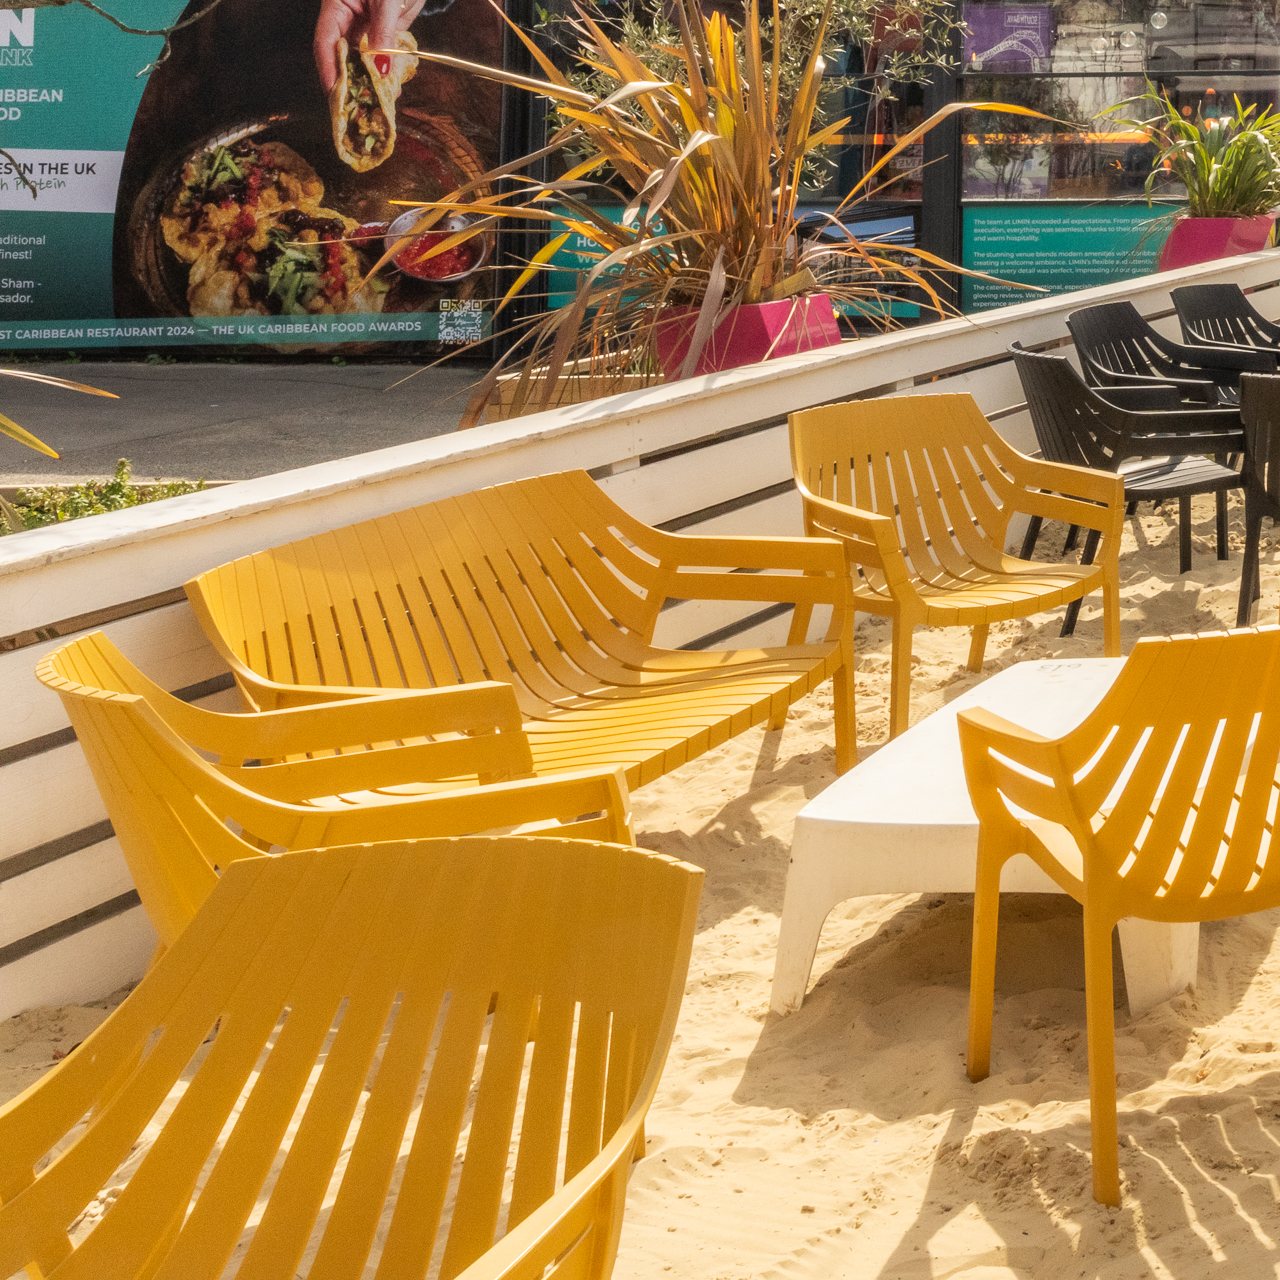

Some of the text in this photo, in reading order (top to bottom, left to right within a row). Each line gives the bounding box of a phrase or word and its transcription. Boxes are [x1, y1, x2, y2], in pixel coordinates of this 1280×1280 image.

[38, 162, 69, 175] THE
[74, 162, 97, 175] UK
[1, 278, 35, 289] Sham
[15, 328, 84, 340] CARIBBEAN
[87, 326, 164, 338] RESTAURANT
[167, 325, 195, 336] 2024
[212, 324, 235, 336] THE
[238, 324, 255, 335] UK
[258, 322, 328, 335] CARIBBEAN
[331, 322, 366, 333] FOOD
[368, 320, 422, 332] AWARDS
